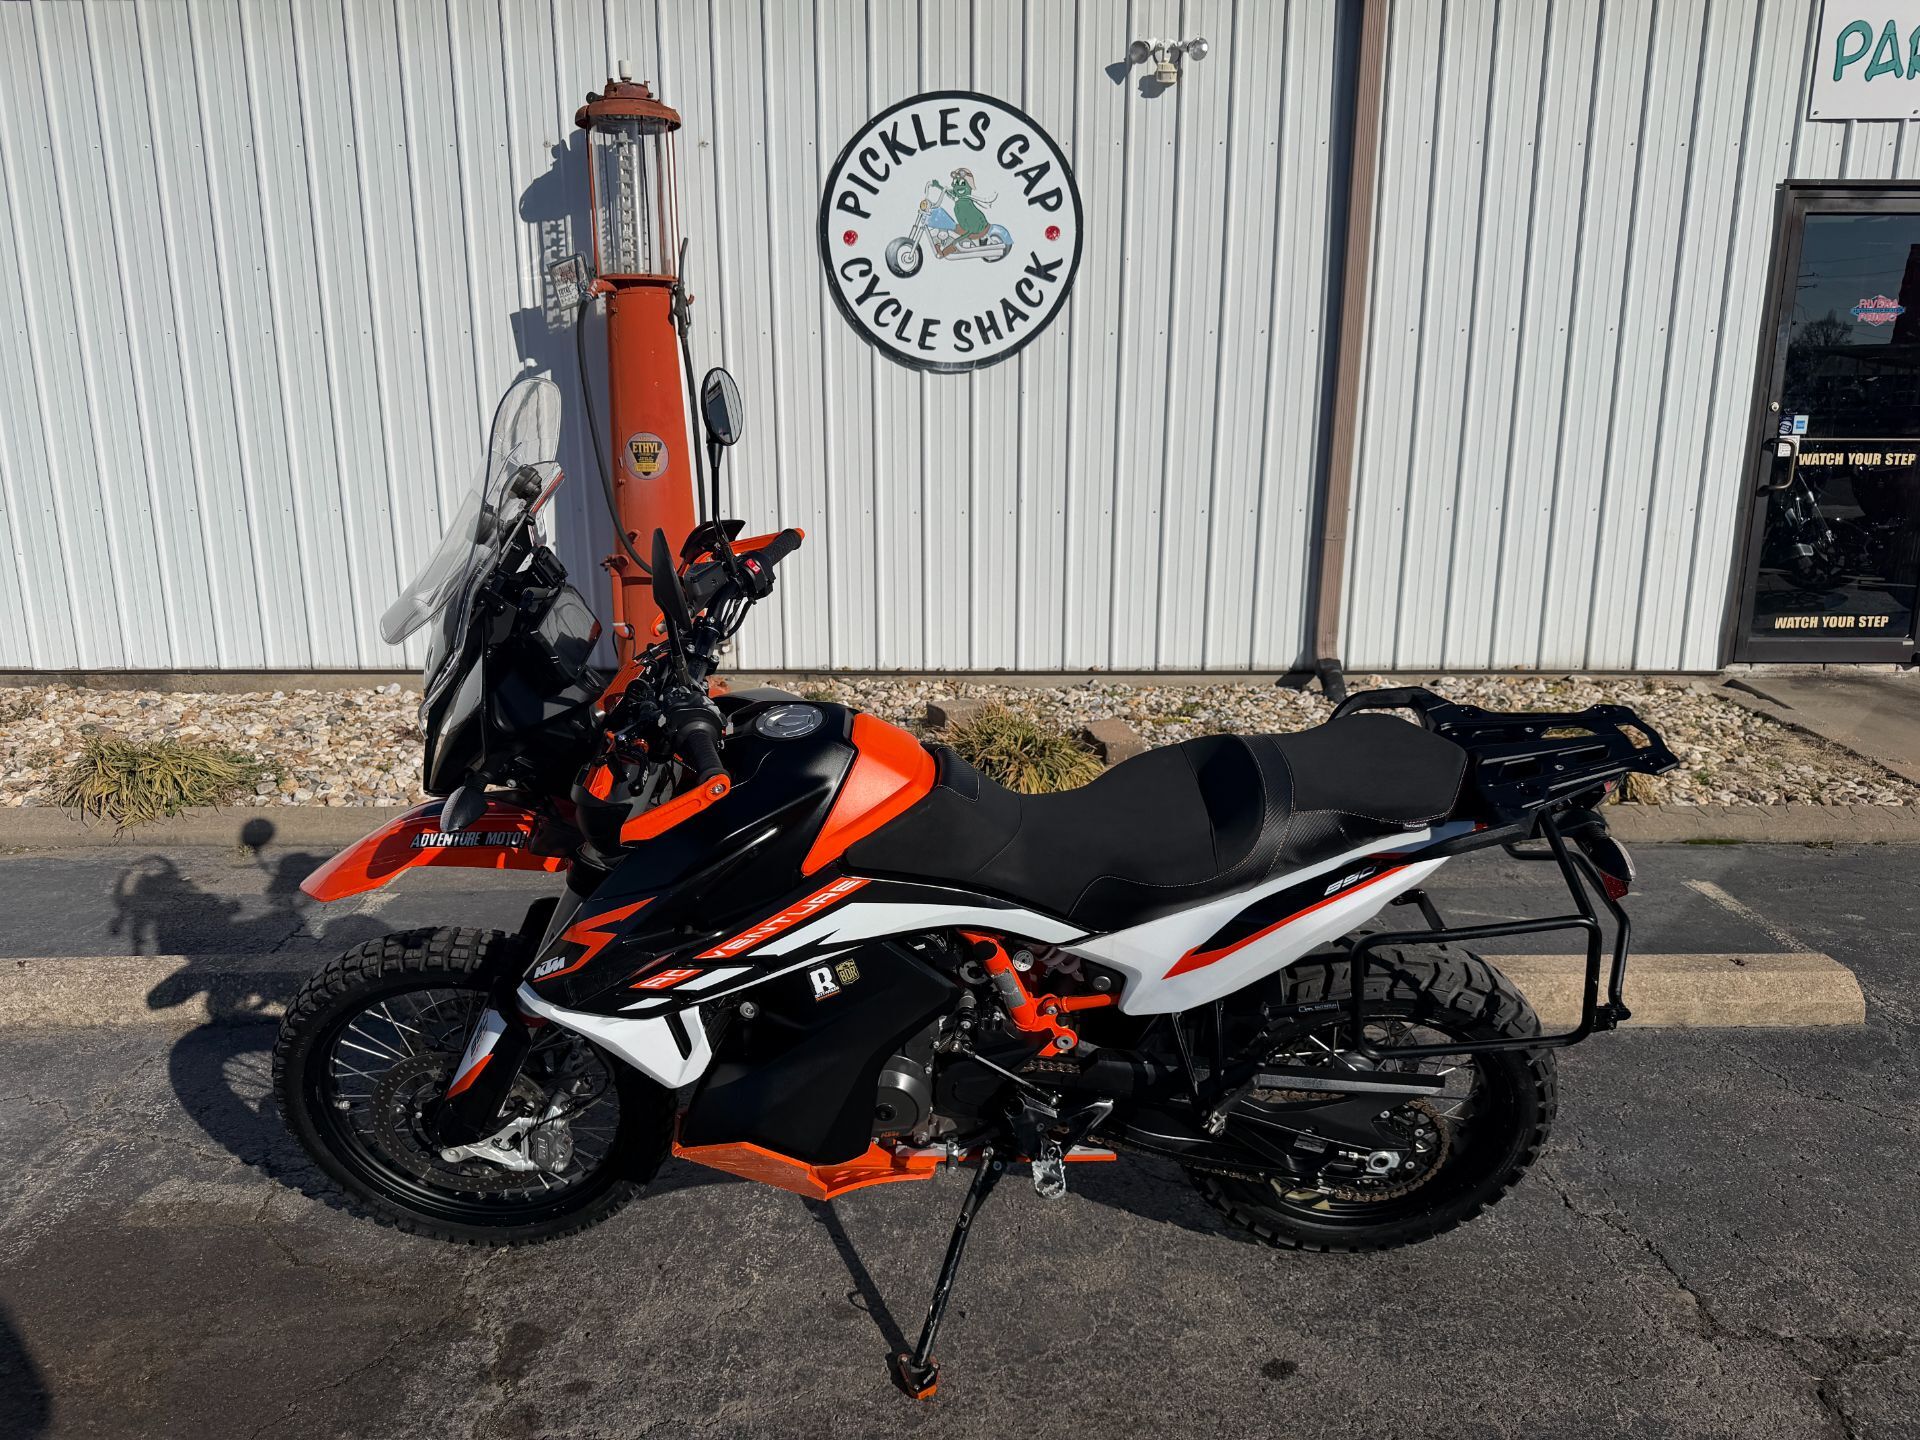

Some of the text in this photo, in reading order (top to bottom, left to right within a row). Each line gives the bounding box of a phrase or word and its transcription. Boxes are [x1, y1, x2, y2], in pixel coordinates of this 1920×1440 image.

[836, 107, 1064, 220] PICKLES GAP
[840, 250, 1064, 353] CYCLE SHACK
[631, 441, 661, 454] ETHYL
[1799, 452, 1917, 466] WATCH YOUR STEP
[1774, 615, 1889, 629] WATCH YOUR STEP
[410, 831, 482, 849] ADVENTURE
[533, 956, 566, 979] KTM
[839, 966, 859, 983] BDR
